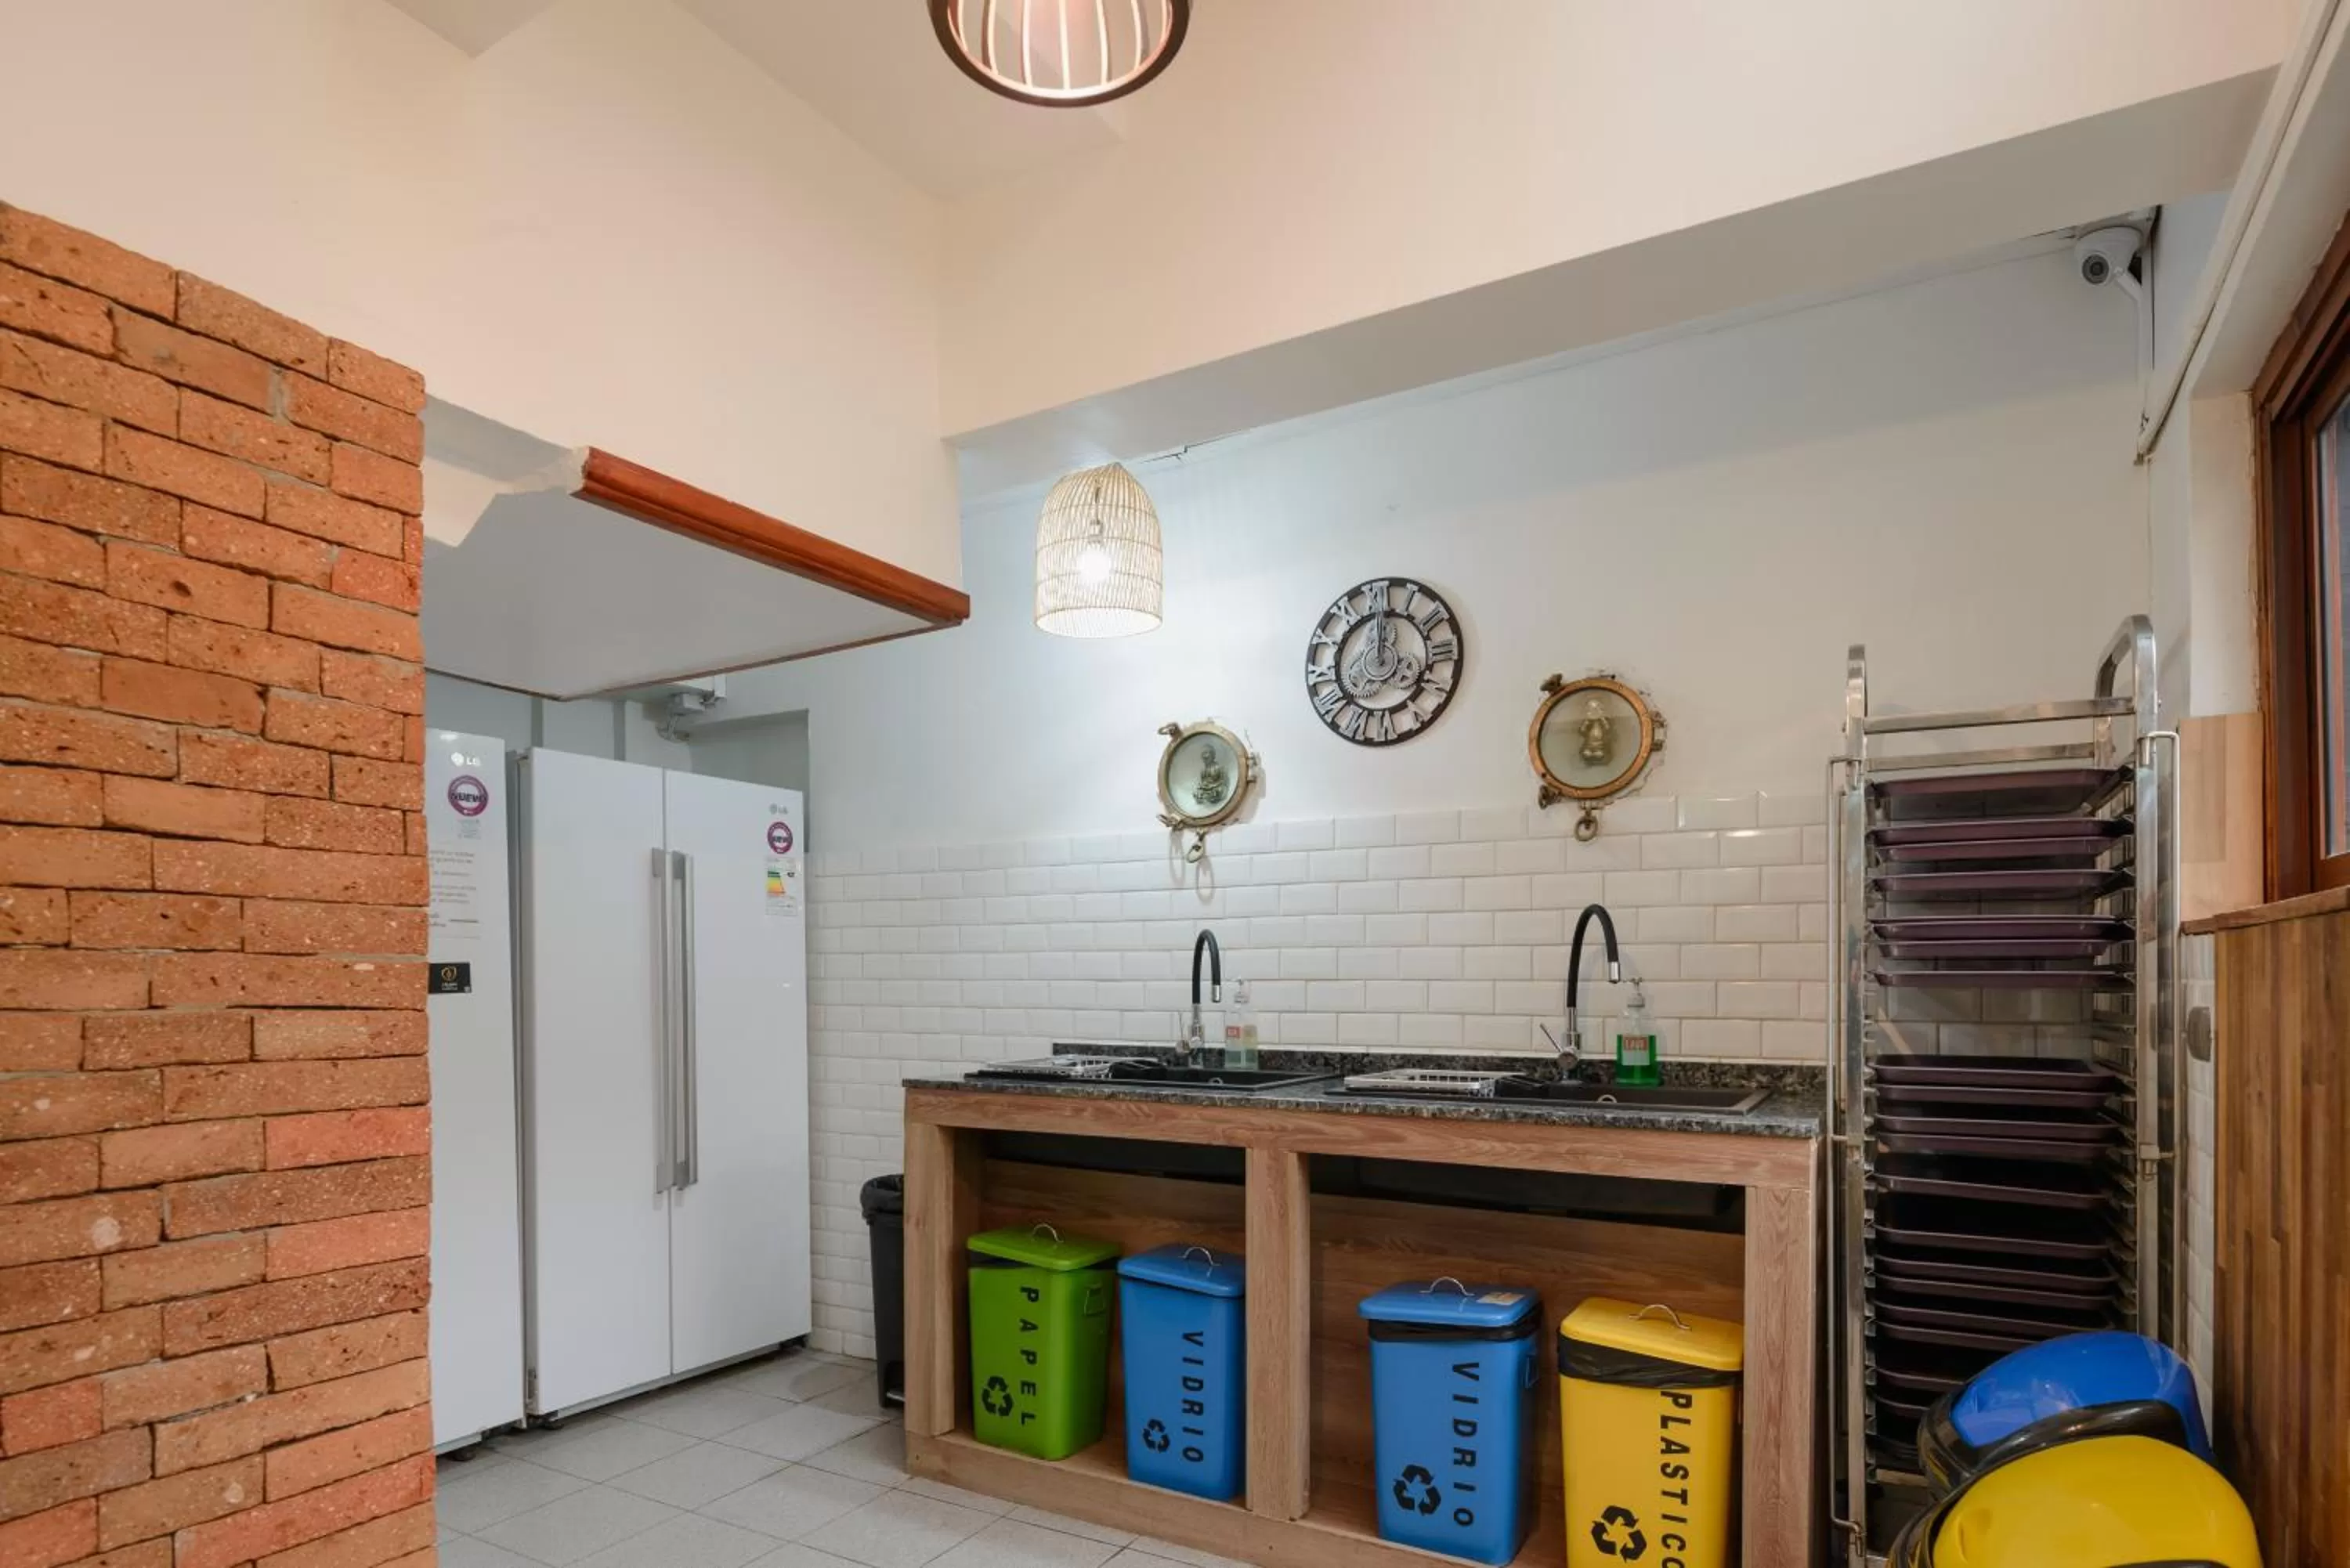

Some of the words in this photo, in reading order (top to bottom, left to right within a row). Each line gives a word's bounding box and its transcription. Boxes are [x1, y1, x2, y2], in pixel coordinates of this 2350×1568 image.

[1420, 601, 1449, 636] II
[1428, 636, 1458, 666] III
[1020, 1286, 1039, 1426] PAPEL
[1182, 1331, 1204, 1463] VIDRIO
[1452, 1362, 1480, 1526] VIDRIO
